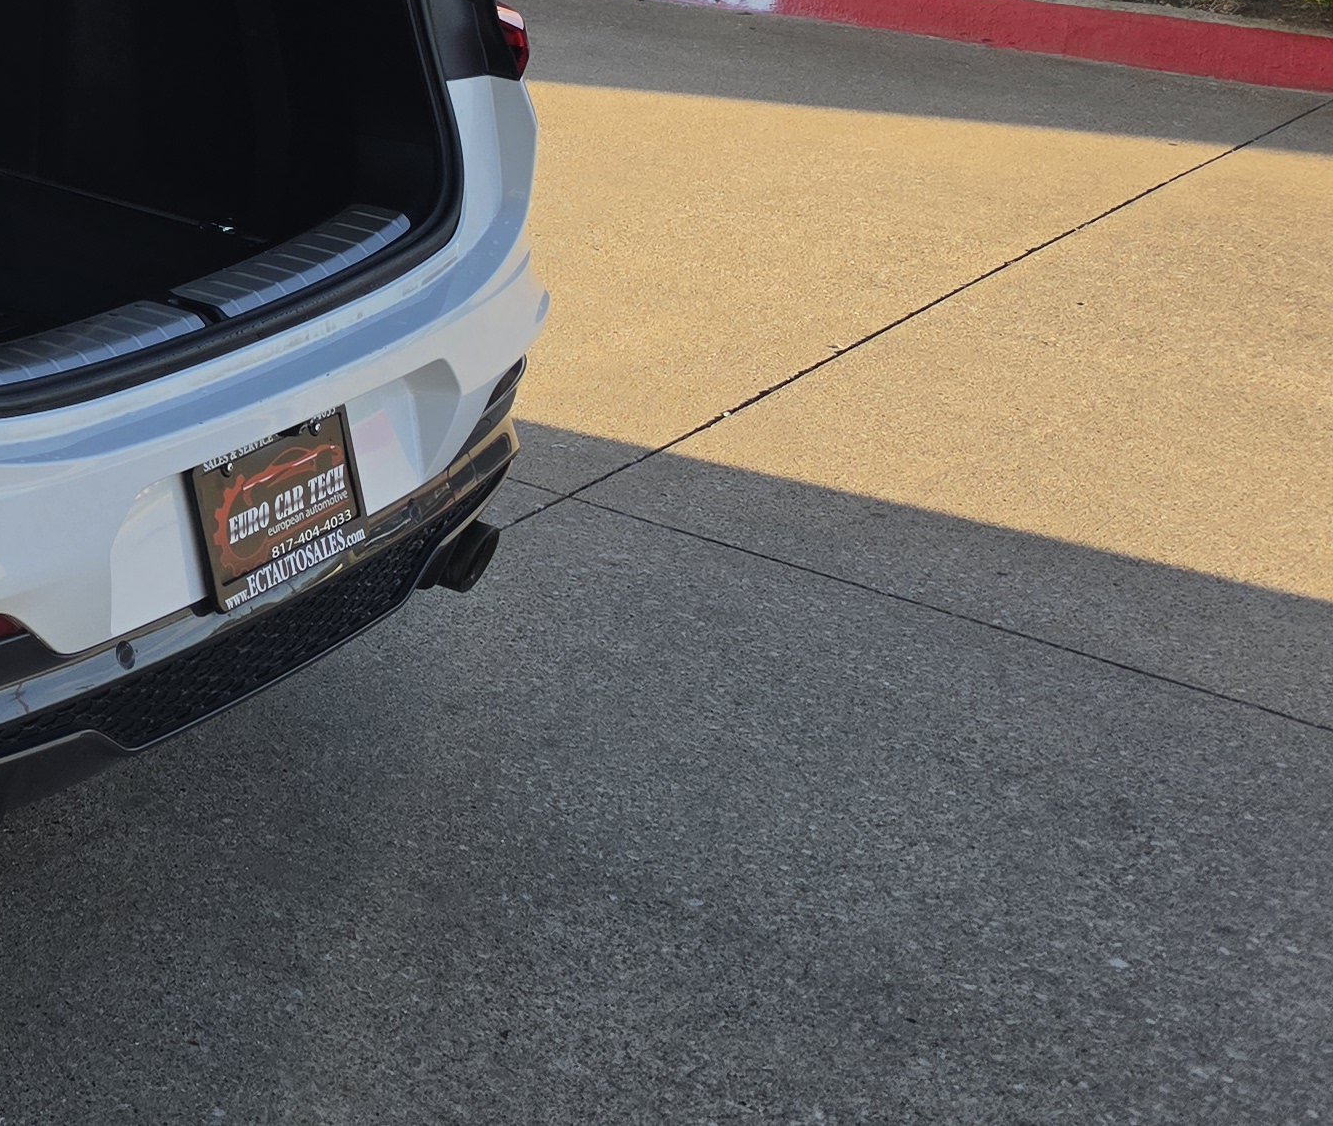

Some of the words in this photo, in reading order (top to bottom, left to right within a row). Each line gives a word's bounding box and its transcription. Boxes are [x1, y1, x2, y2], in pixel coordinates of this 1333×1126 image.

[202, 454, 229, 473] SALES
[238, 435, 274, 457] SERVICE
[228, 501, 270, 545] EURO
[274, 485, 305, 521] CAR
[307, 463, 346, 505] TECH
[267, 513, 305, 537] european
[305, 490, 348, 518] automotive
[271, 509, 352, 559] 817-404-4033
[225, 528, 366, 611] www.ECTAUTOSALES.com
